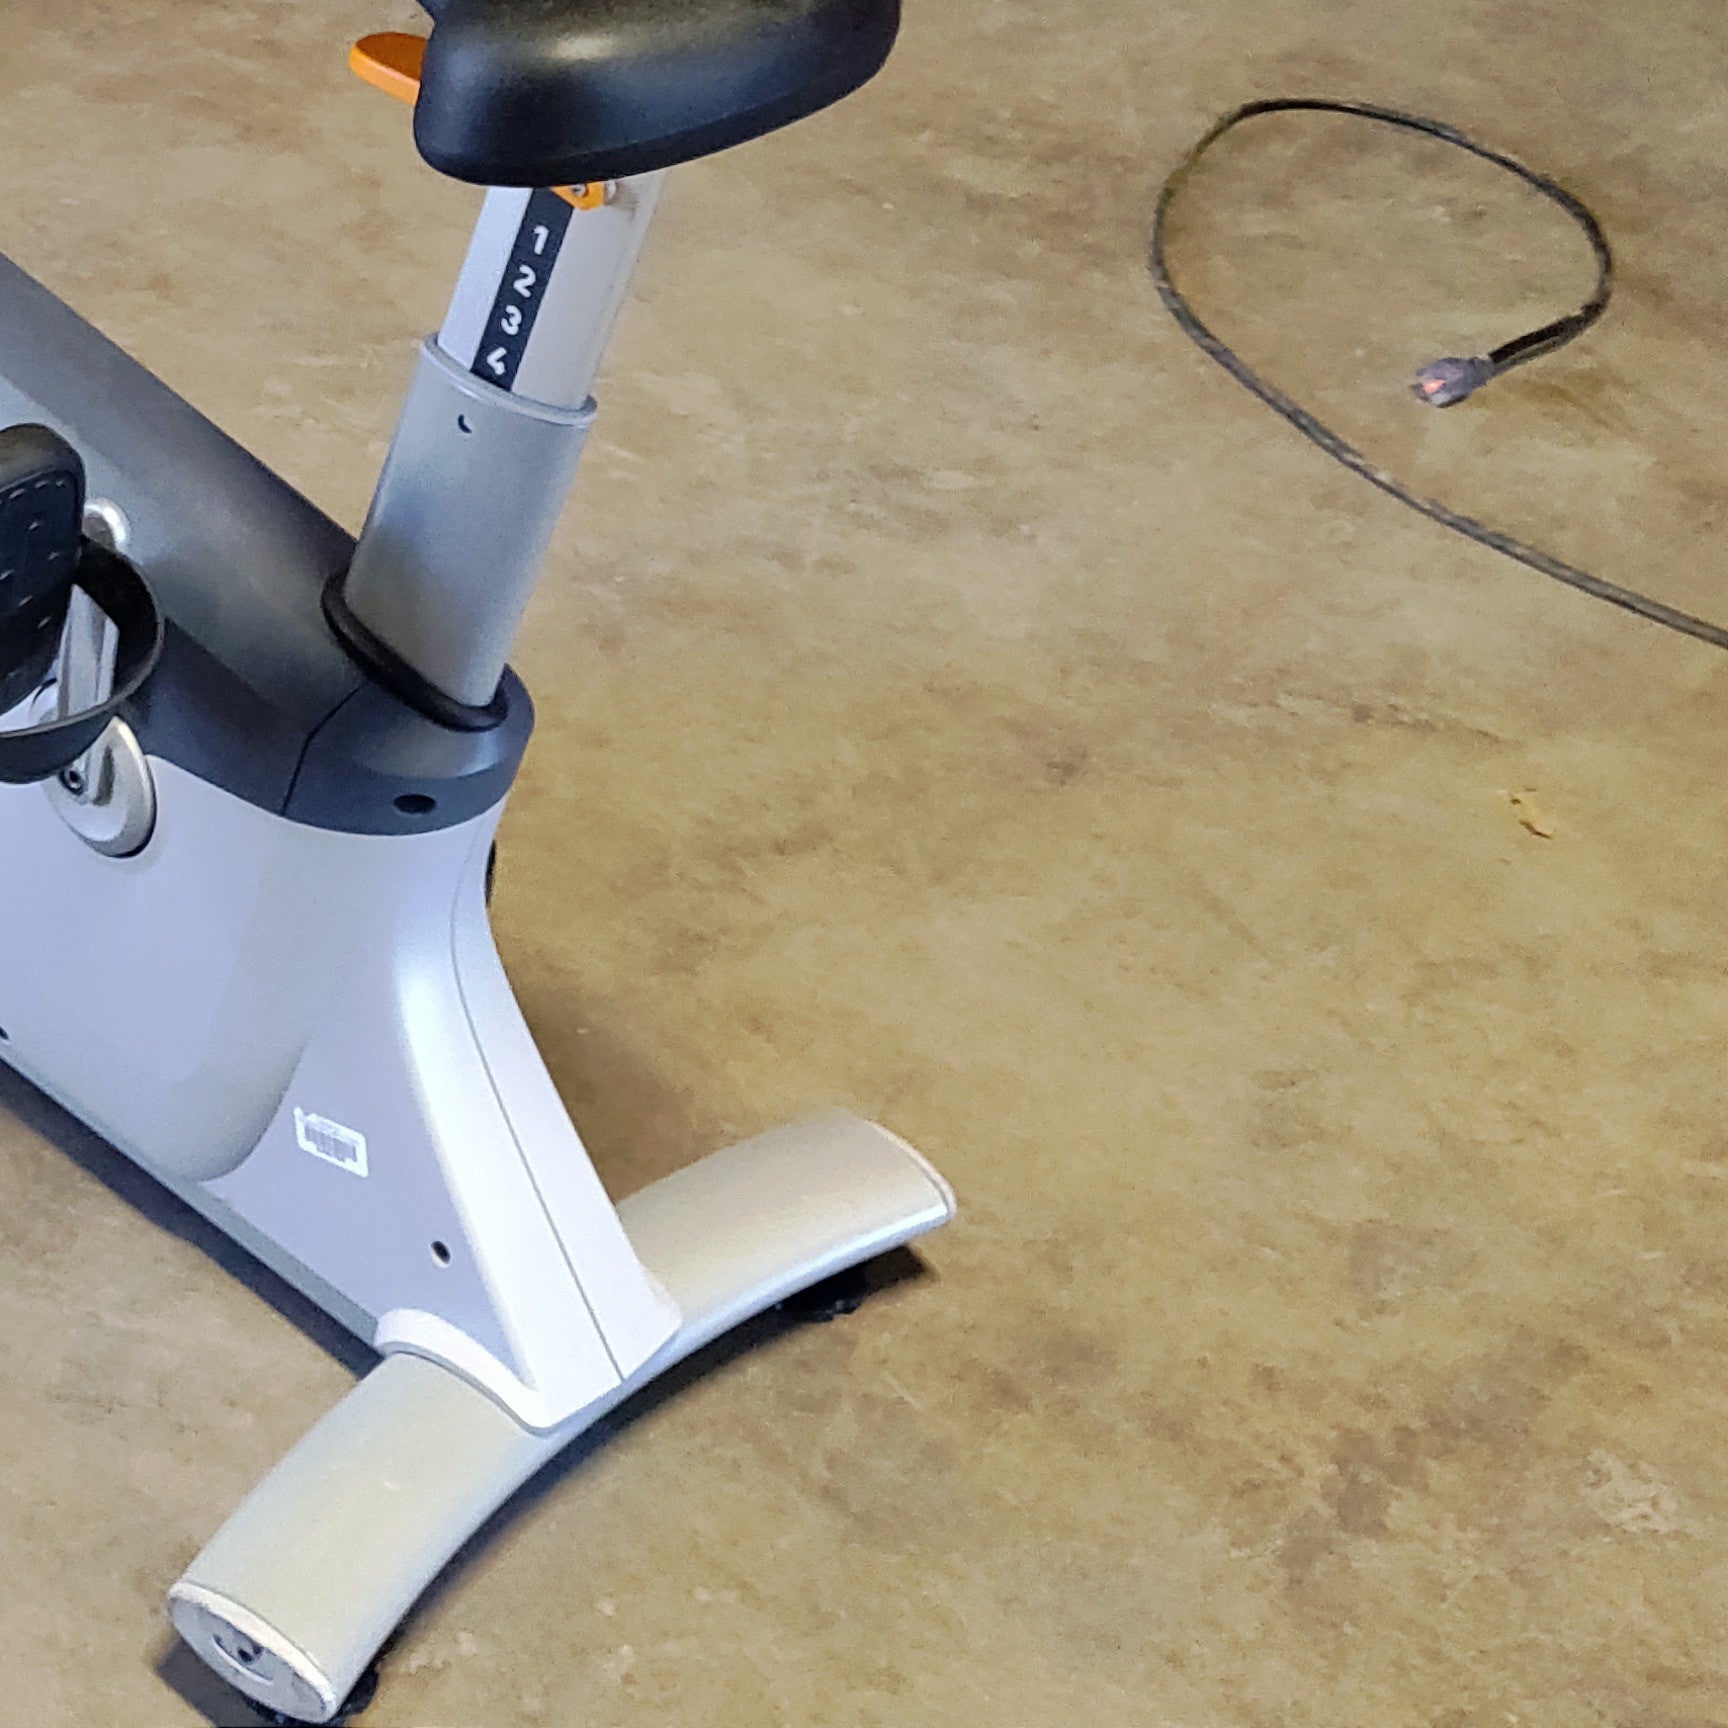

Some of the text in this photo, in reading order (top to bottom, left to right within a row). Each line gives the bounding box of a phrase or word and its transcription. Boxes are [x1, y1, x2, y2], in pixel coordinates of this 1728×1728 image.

[533, 224, 549, 255] 1
[513, 264, 536, 298] 2
[500, 304, 522, 335] 3
